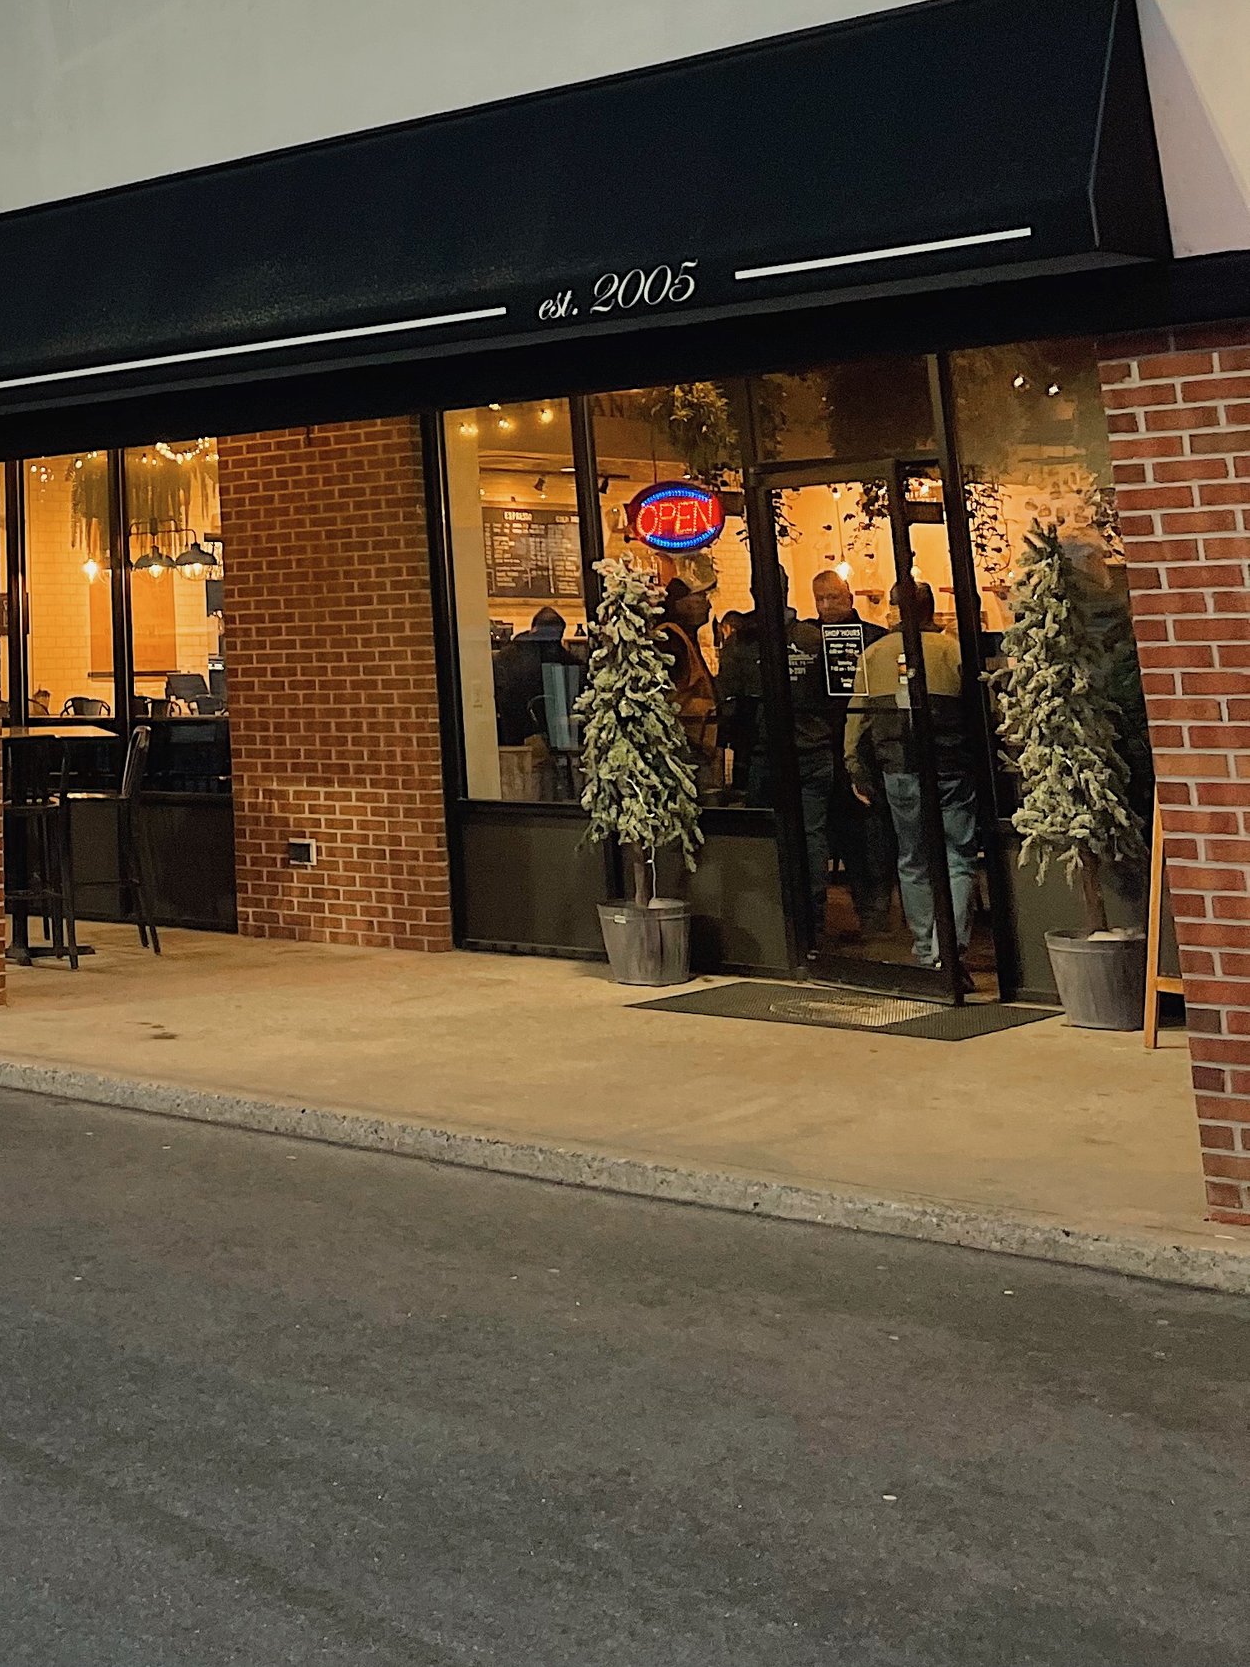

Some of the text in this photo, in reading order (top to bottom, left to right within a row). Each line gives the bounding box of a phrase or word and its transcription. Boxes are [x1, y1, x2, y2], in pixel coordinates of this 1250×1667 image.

[538, 258, 699, 321] est. 2005
[636, 498, 713, 536] OPEN
